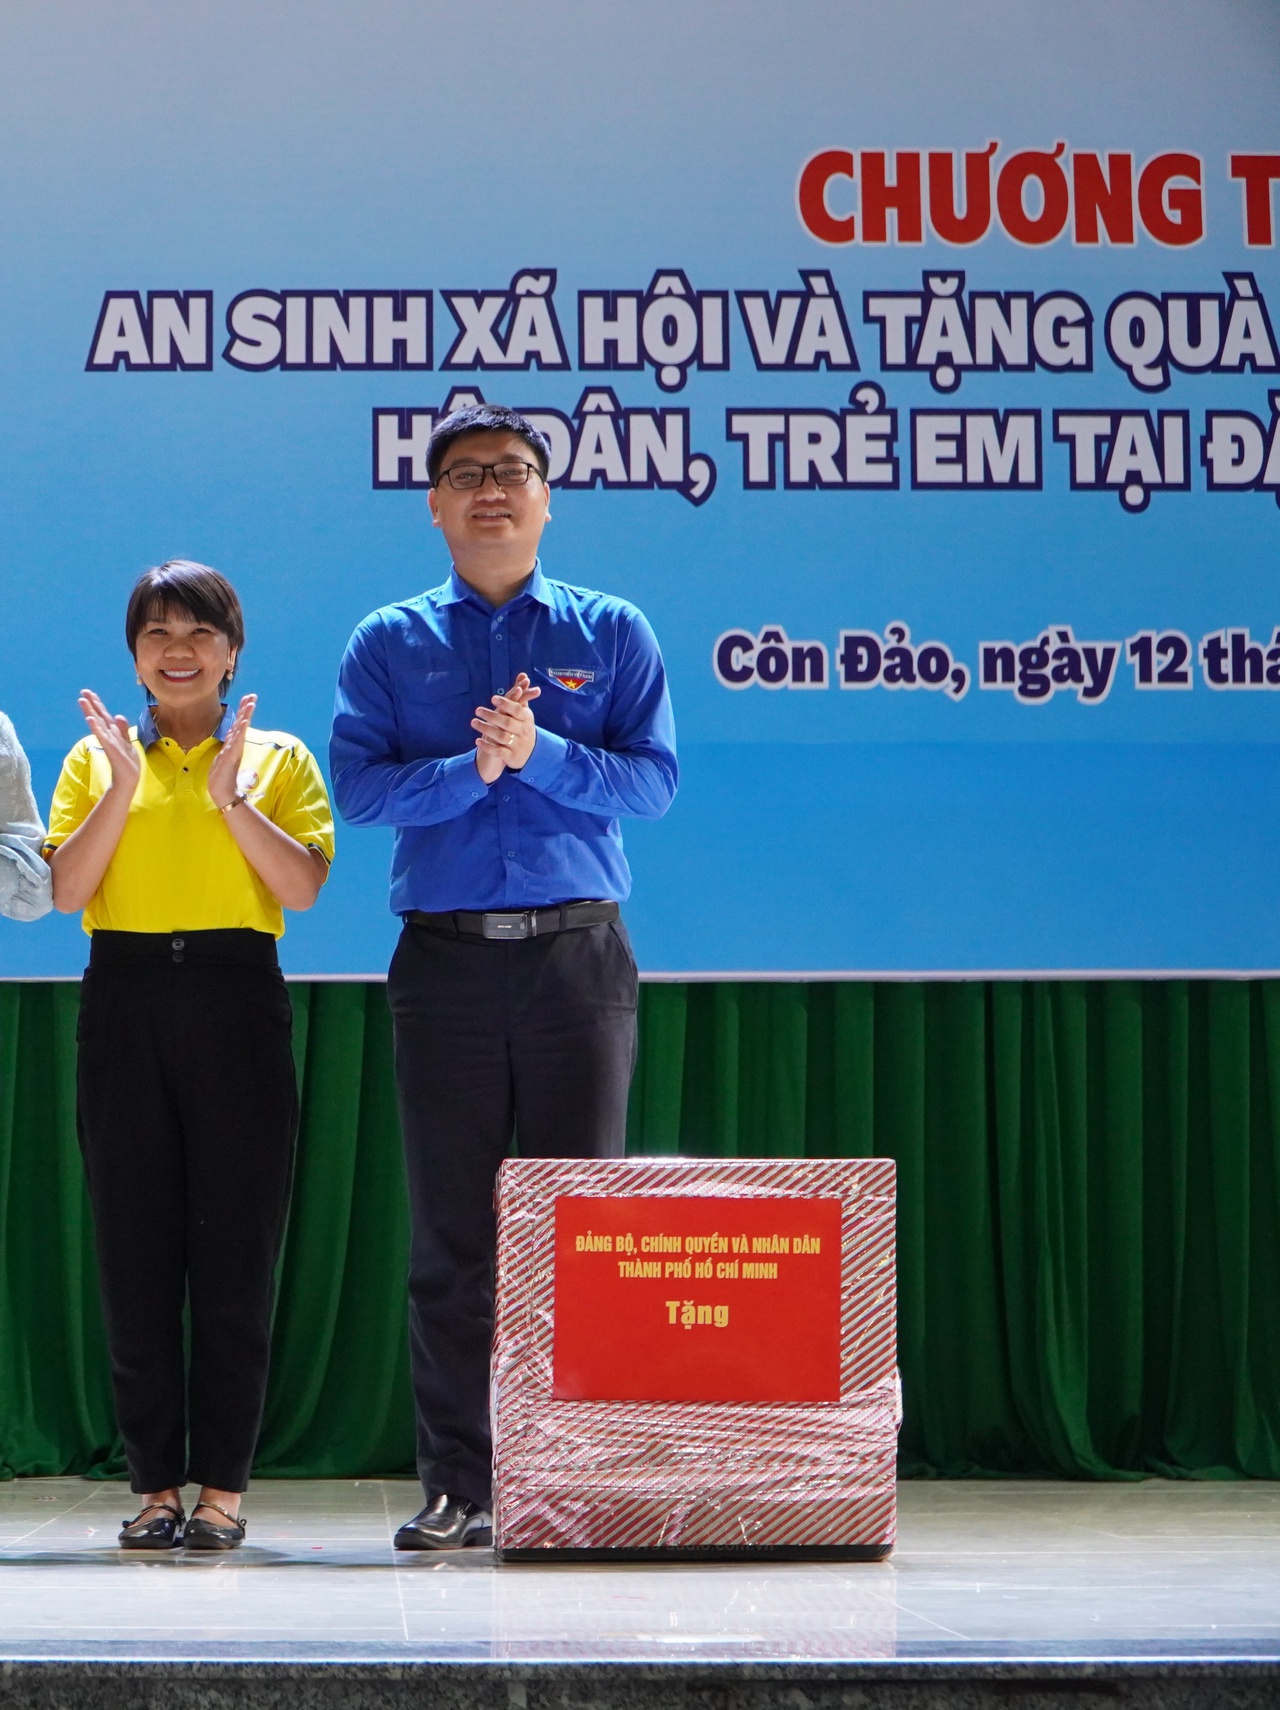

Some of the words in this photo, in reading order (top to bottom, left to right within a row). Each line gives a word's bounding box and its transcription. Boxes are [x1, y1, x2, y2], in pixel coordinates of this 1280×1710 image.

[798, 141, 1204, 246] CHƯƠNG
[88, 293, 210, 369] AN
[225, 291, 431, 369] SINH
[443, 271, 568, 369] XÃ
[580, 271, 727, 390] HỘI
[738, 271, 857, 369] VÀ
[865, 272, 1091, 391] TẶNG
[1106, 274, 1280, 390] QUÀ
[727, 383, 897, 487] TRẺ
[912, 410, 1040, 488] EM
[1055, 411, 1188, 510] TẠI
[716, 630, 825, 685] Côn
[839, 626, 966, 693] Đảo,
[982, 629, 1117, 698] ngày
[1129, 635, 1188, 685] 12
[575, 1230, 612, 1252] ĐẢNG
[615, 1232, 637, 1256] BỘ,
[641, 1232, 682, 1253] CHÍNH
[685, 1231, 728, 1255] QUYỀN
[731, 1233, 749, 1254] VÀ
[752, 1234, 790, 1254] NHÂN
[793, 1234, 821, 1255] DÂN
[618, 1258, 662, 1278] THÀNH
[665, 1256, 692, 1279] PHỐ
[695, 1257, 713, 1279] HỒ
[716, 1259, 739, 1279] CHÍ
[742, 1262, 778, 1279] MINH
[665, 1300, 729, 1329] Tặng
